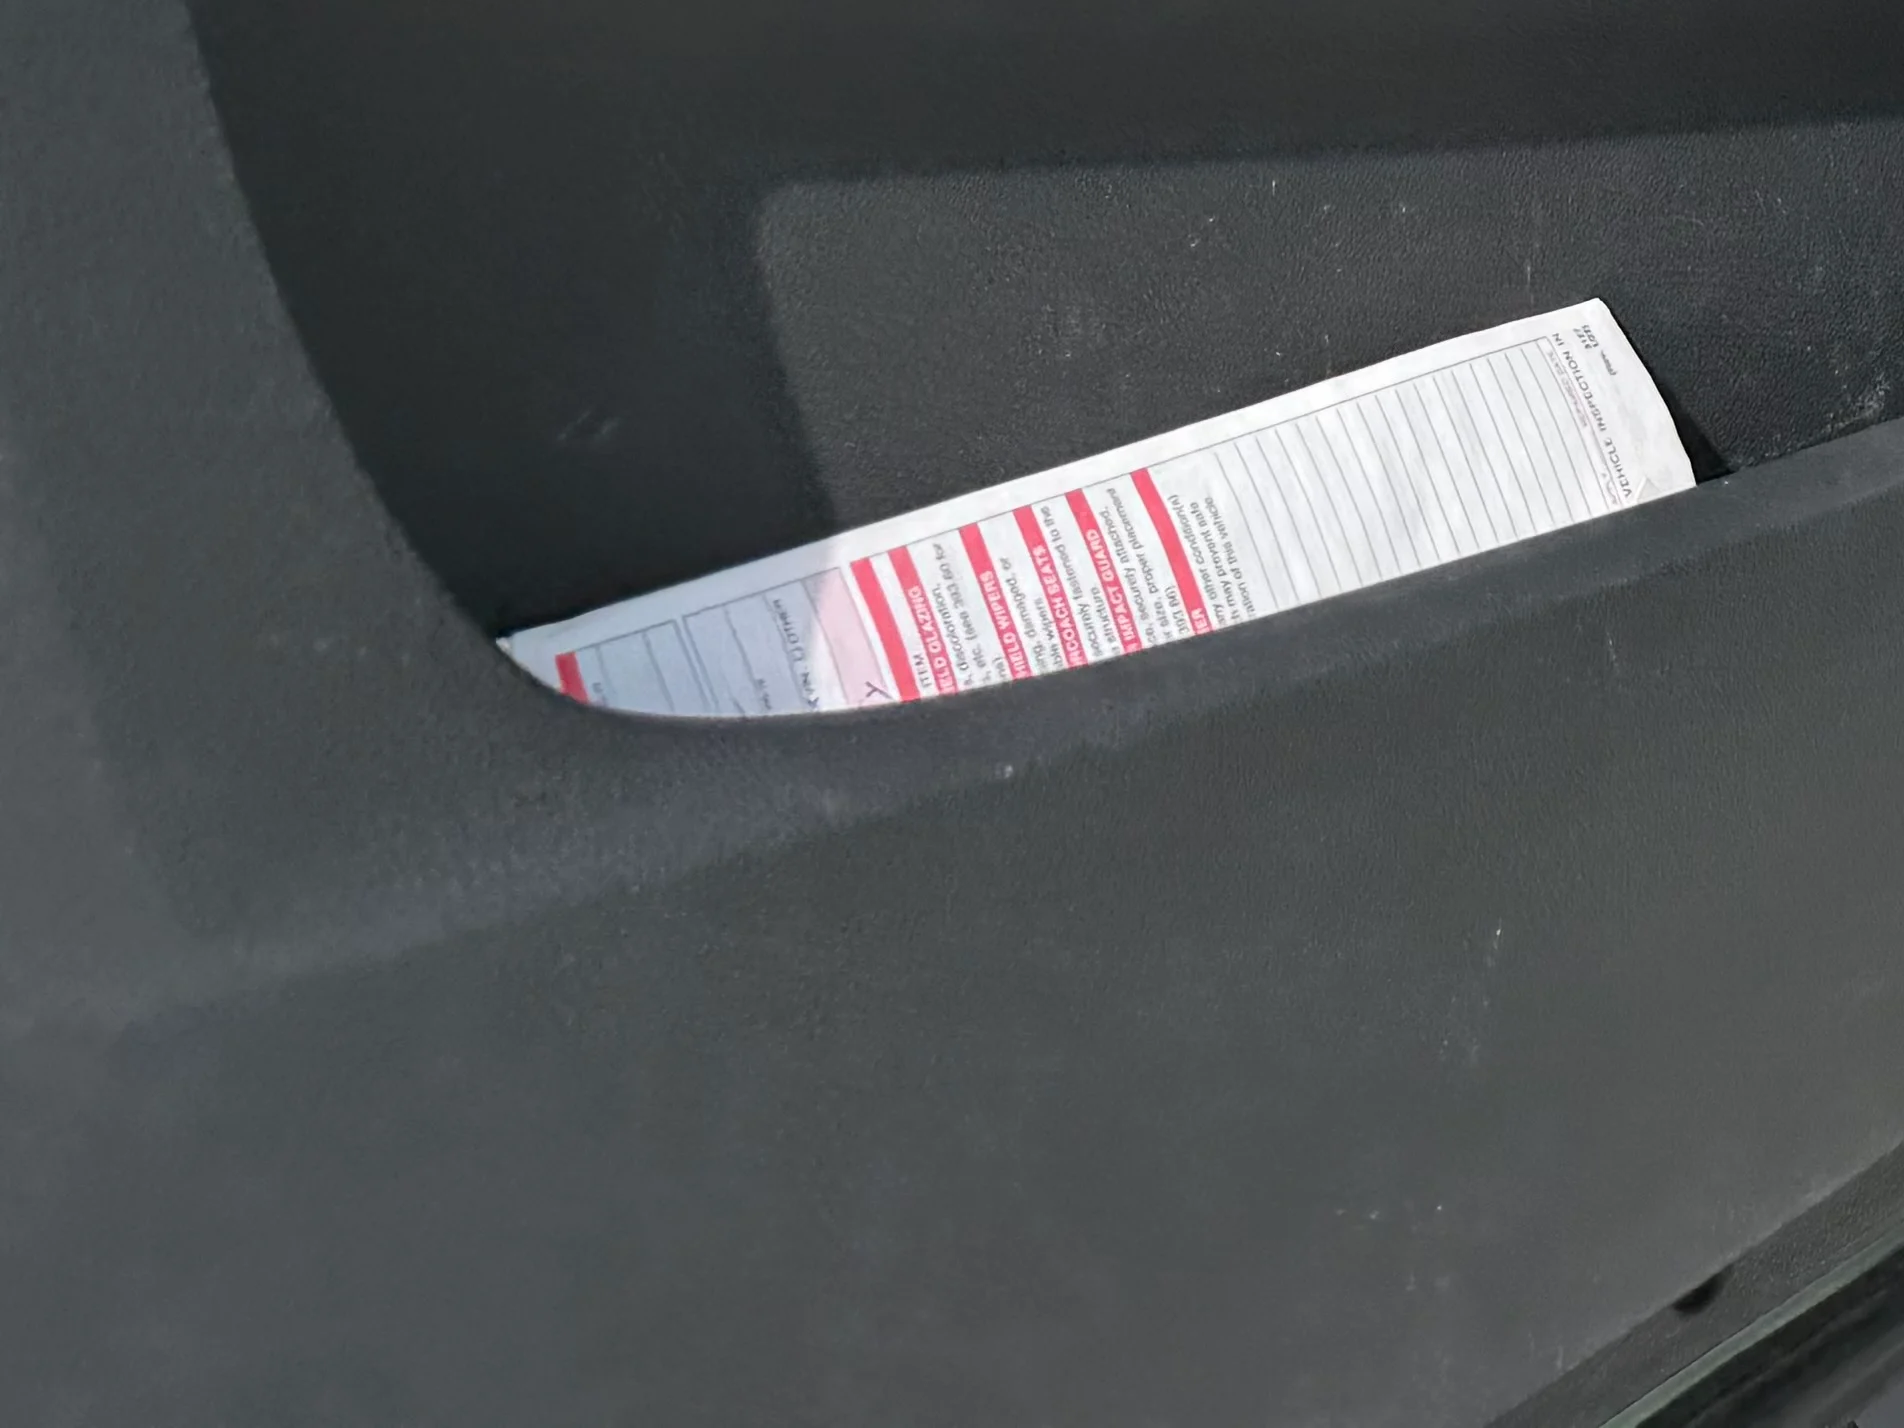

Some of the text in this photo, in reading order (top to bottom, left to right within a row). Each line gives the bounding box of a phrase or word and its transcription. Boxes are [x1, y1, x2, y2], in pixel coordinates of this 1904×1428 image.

[1562, 349, 1607, 432] INSPECTION
[1602, 436, 1634, 497] VEHICLE
[1039, 504, 1054, 526] the
[1048, 528, 1061, 542] to
[1032, 544, 1060, 594] SEATS
[1053, 543, 1084, 600] fastened
[1134, 551, 1159, 594] proper
[1200, 529, 1227, 577] prevent
[978, 569, 1011, 629] WIPERS
[1084, 527, 1135, 640] IMPACT GUARD
[1122, 565, 1150, 621] securely
[1219, 578, 1236, 607] may
[906, 584, 943, 654] GLAZING
[912, 653, 932, 688] ITEM
